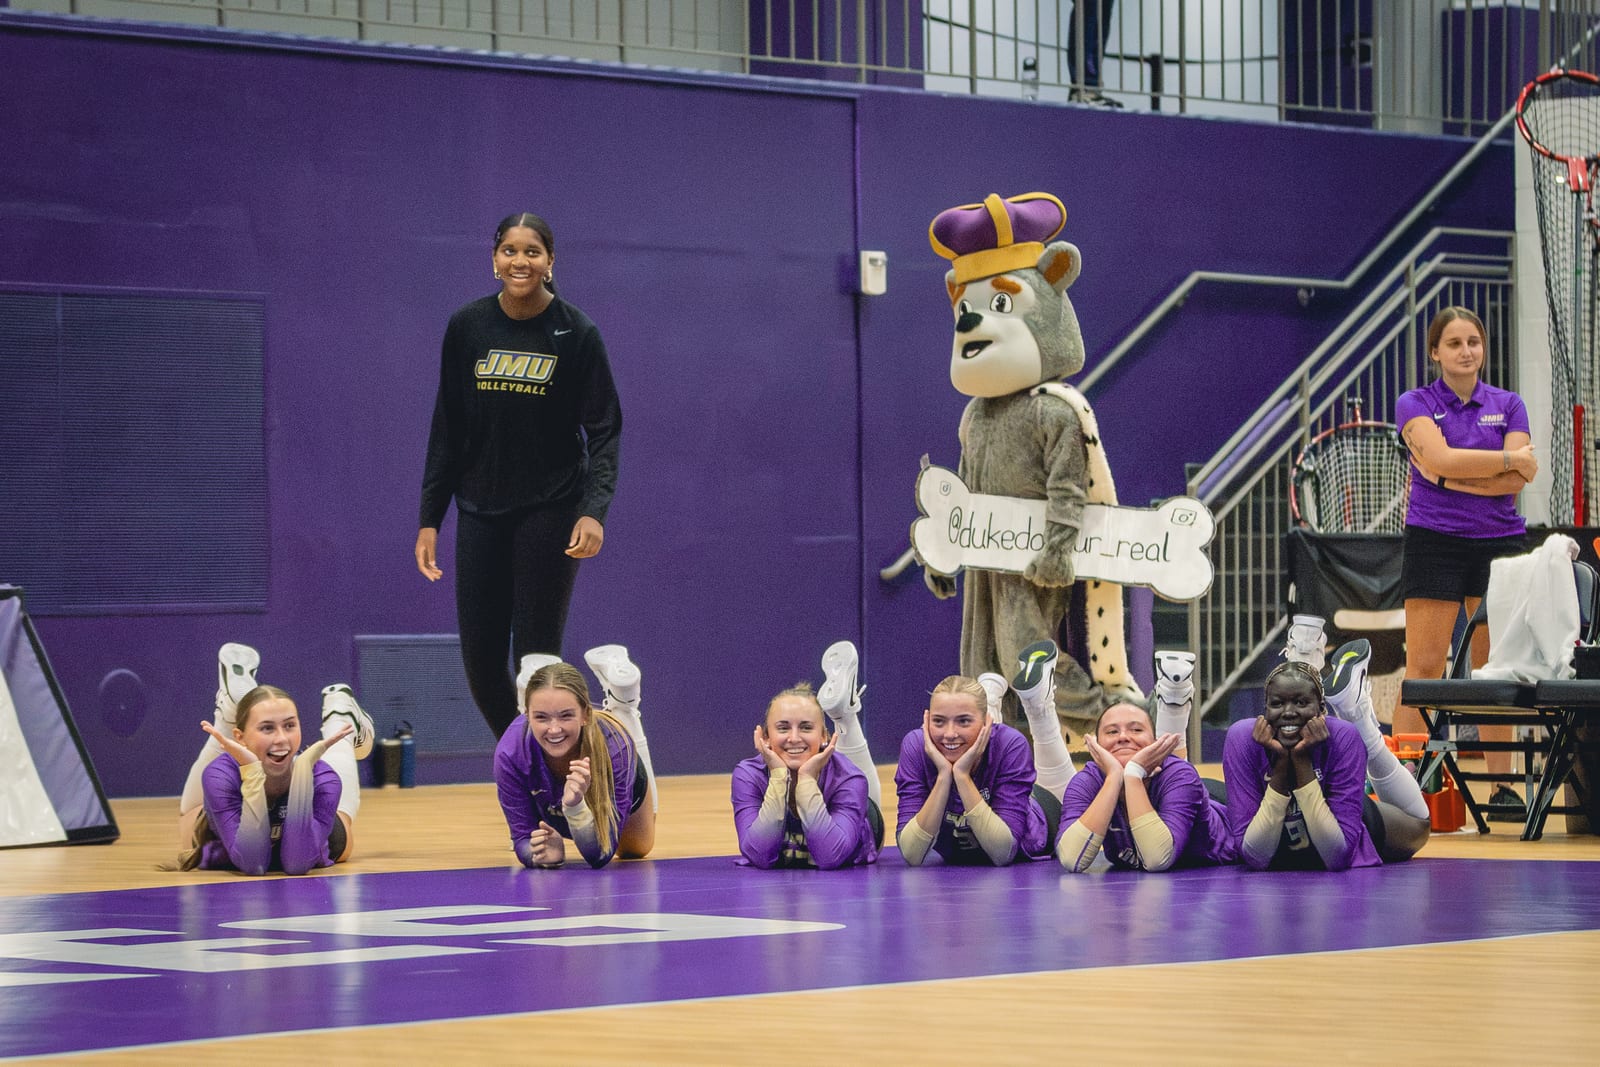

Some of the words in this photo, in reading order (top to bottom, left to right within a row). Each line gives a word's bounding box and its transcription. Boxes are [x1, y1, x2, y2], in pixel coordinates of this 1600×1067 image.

[476, 351, 557, 382] JMU
[948, 505, 1171, 562] @dukedour_real
[0, 904, 847, 987] ES
